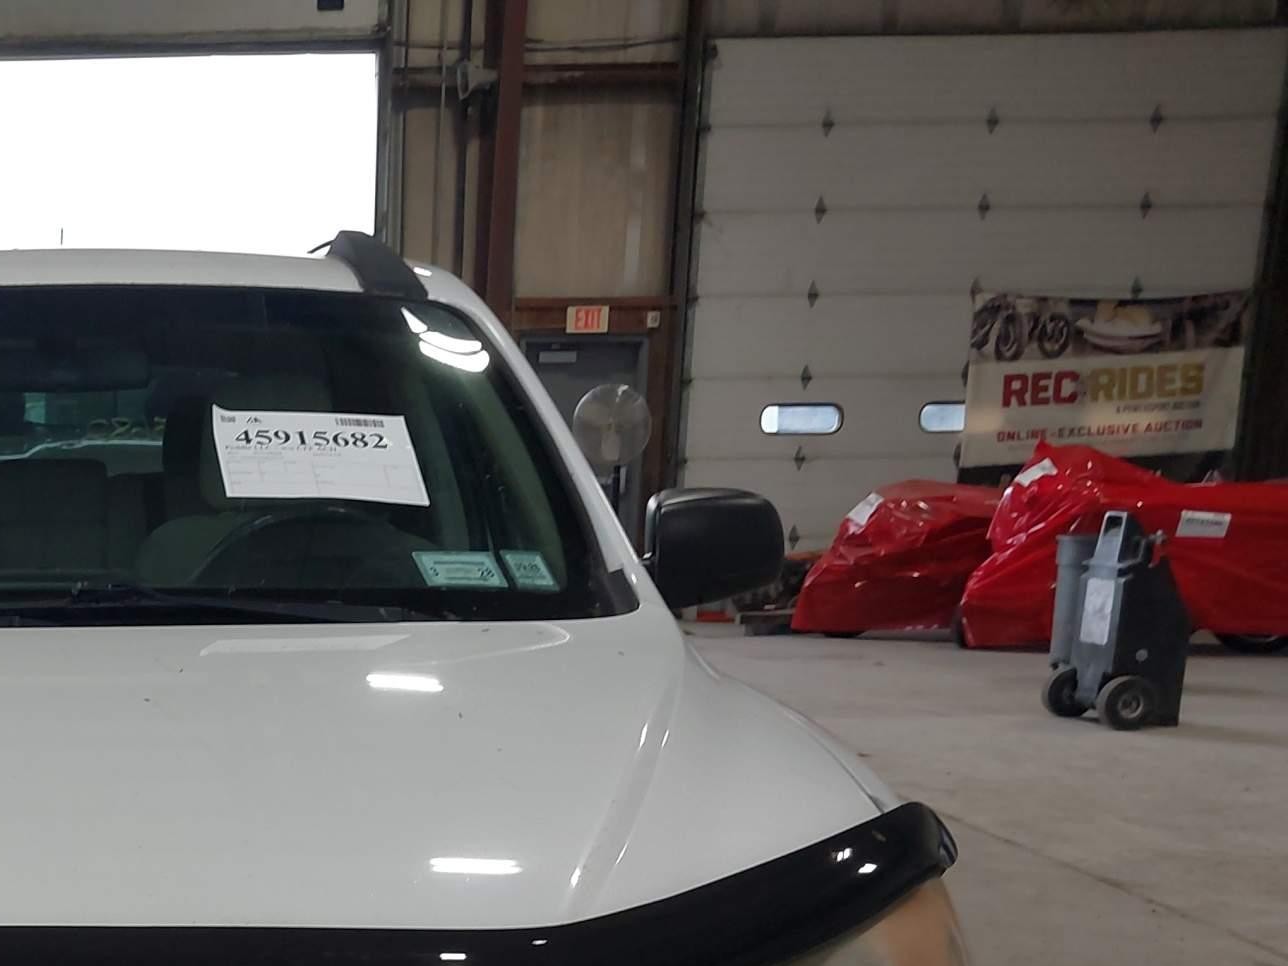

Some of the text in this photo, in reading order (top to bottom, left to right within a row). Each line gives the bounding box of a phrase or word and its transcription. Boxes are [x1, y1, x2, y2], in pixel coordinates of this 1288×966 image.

[1002, 362, 1205, 408] REC RIDES
[1144, 418, 1203, 435] AUCTION
[235, 428, 389, 450] 45915682
